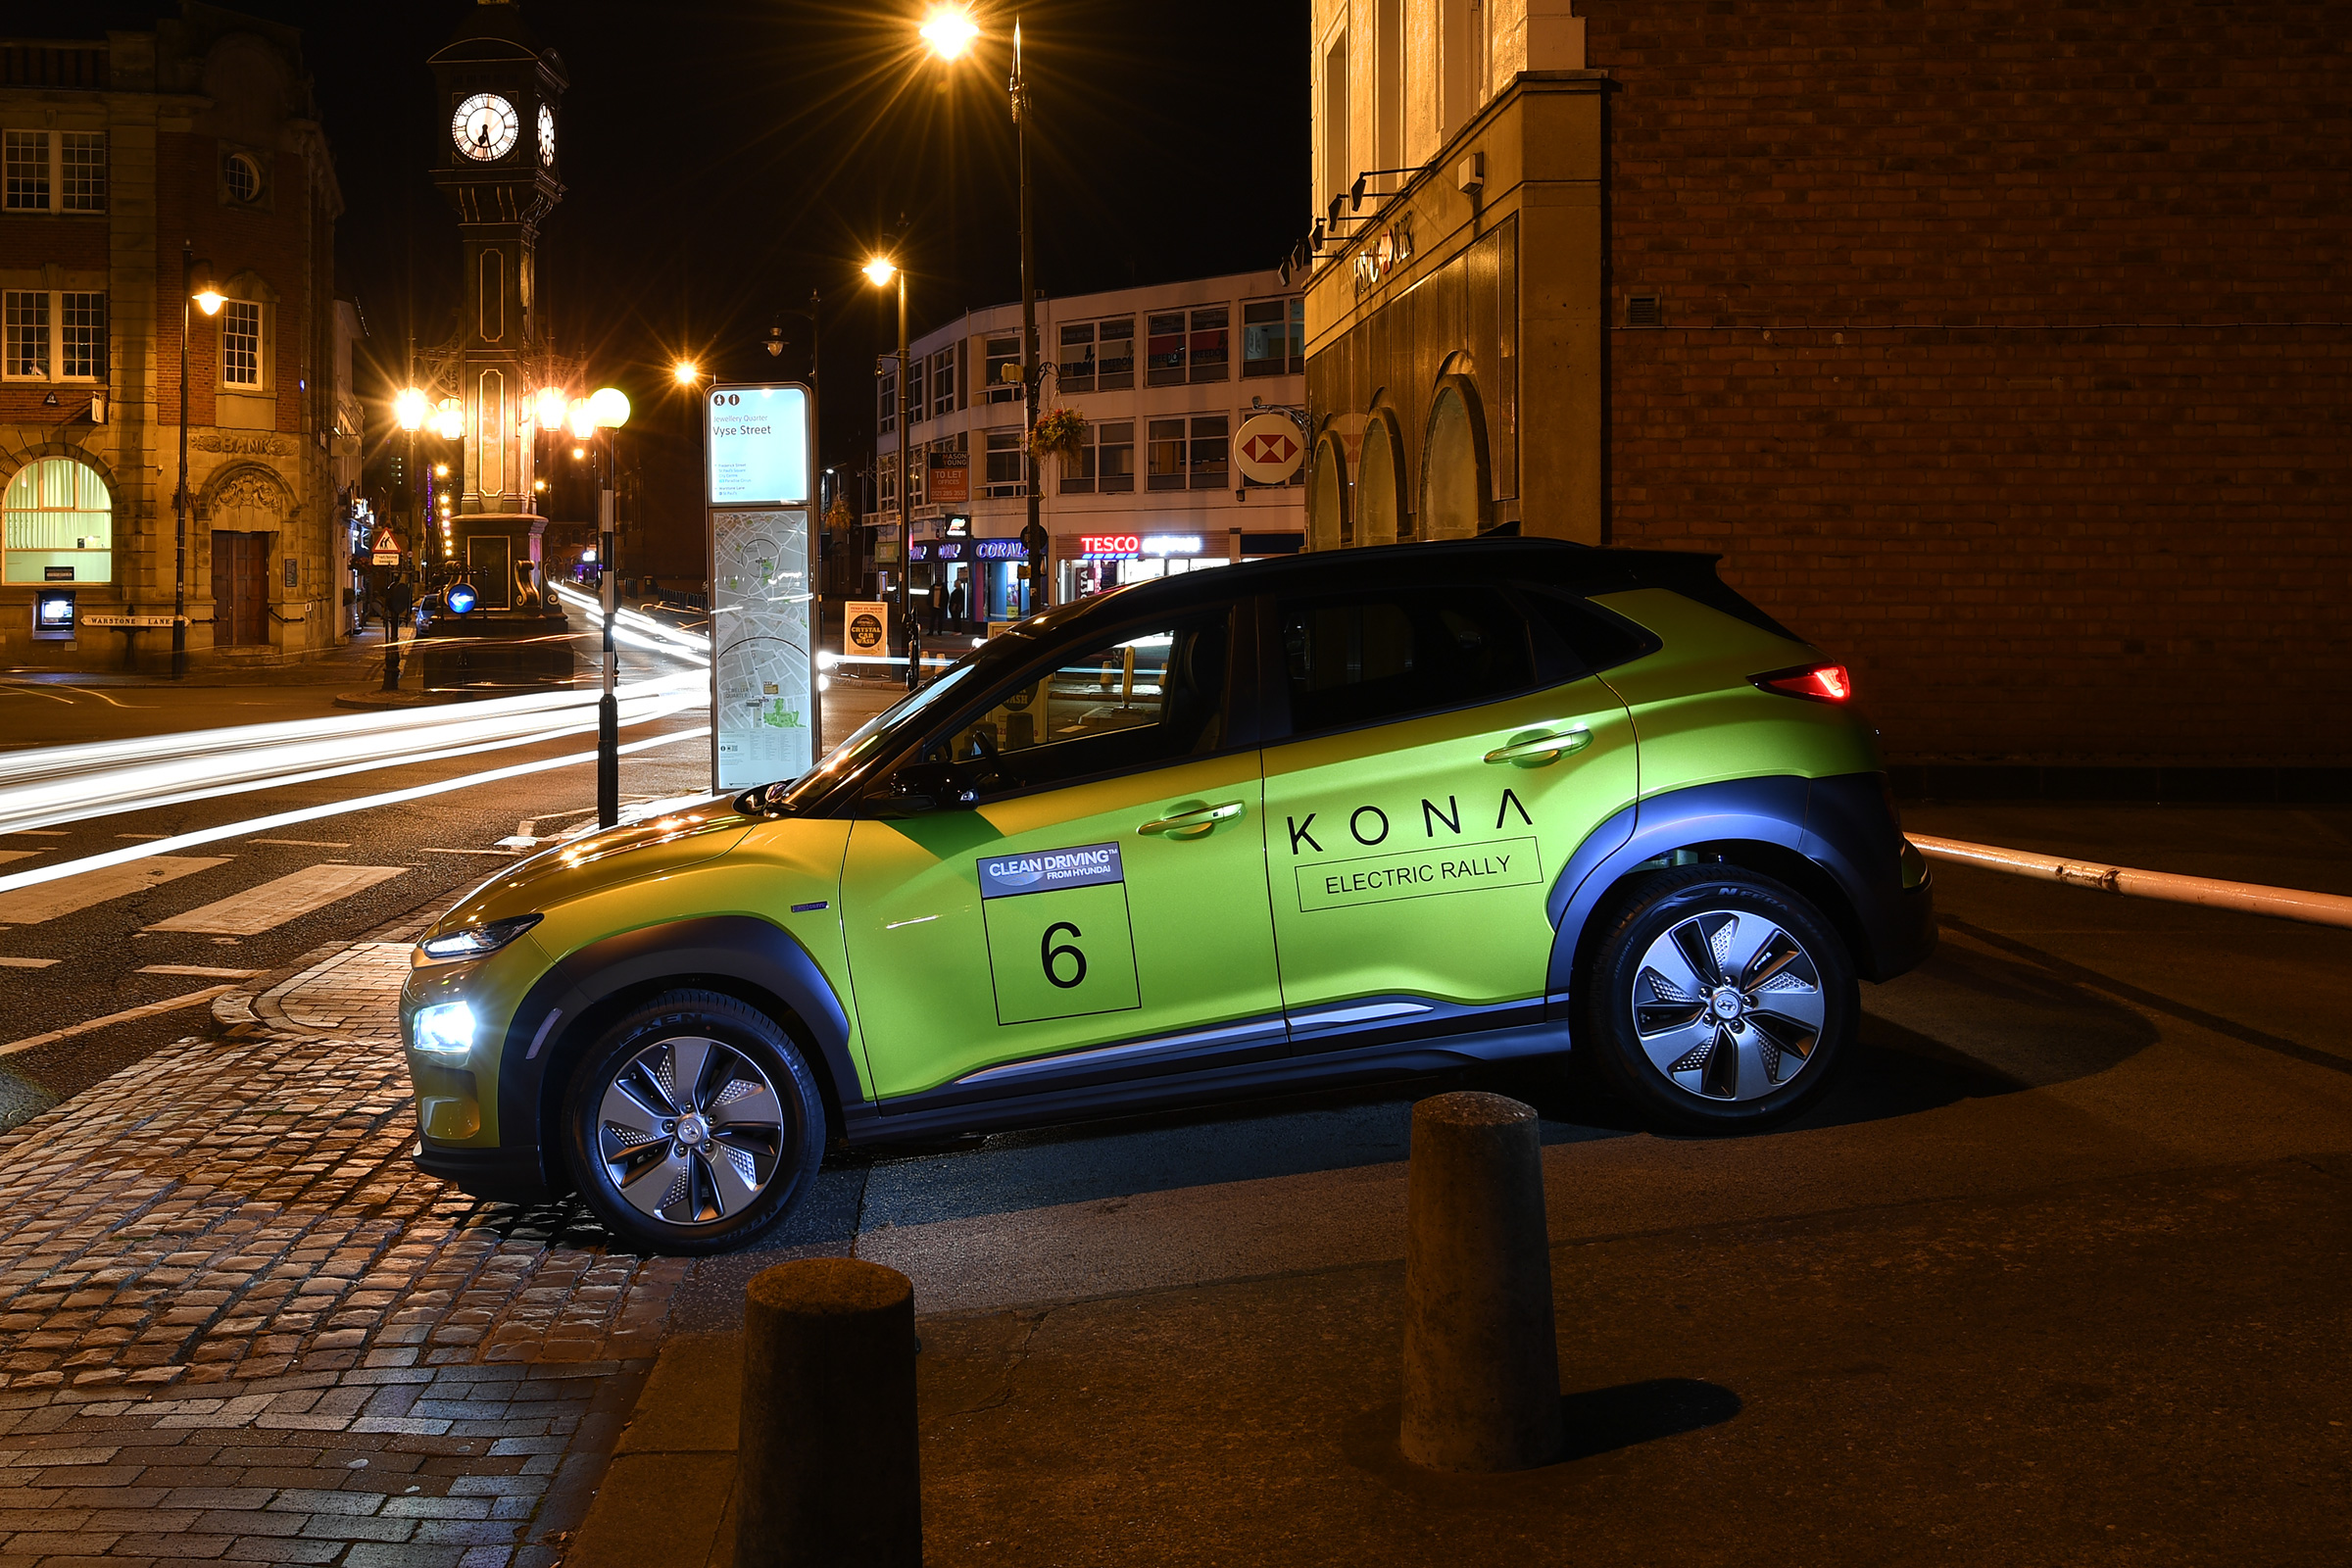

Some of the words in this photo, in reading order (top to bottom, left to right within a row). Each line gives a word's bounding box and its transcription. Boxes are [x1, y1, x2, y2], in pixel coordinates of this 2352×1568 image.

[712, 425, 737, 437] Vyse
[740, 425, 771, 435] Street
[222, 436, 270, 455] BANK
[976, 542, 1023, 559] CORAL
[1081, 536, 1139, 552] TESCO
[1286, 788, 1533, 855] KONA
[989, 858, 1043, 877] CLEAN
[1047, 869, 1072, 880] FROM
[1073, 864, 1111, 877] HYUNDAI
[1325, 864, 1434, 894] ELECTRIC
[1441, 855, 1511, 879] RALLY
[1041, 921, 1087, 989] 6
